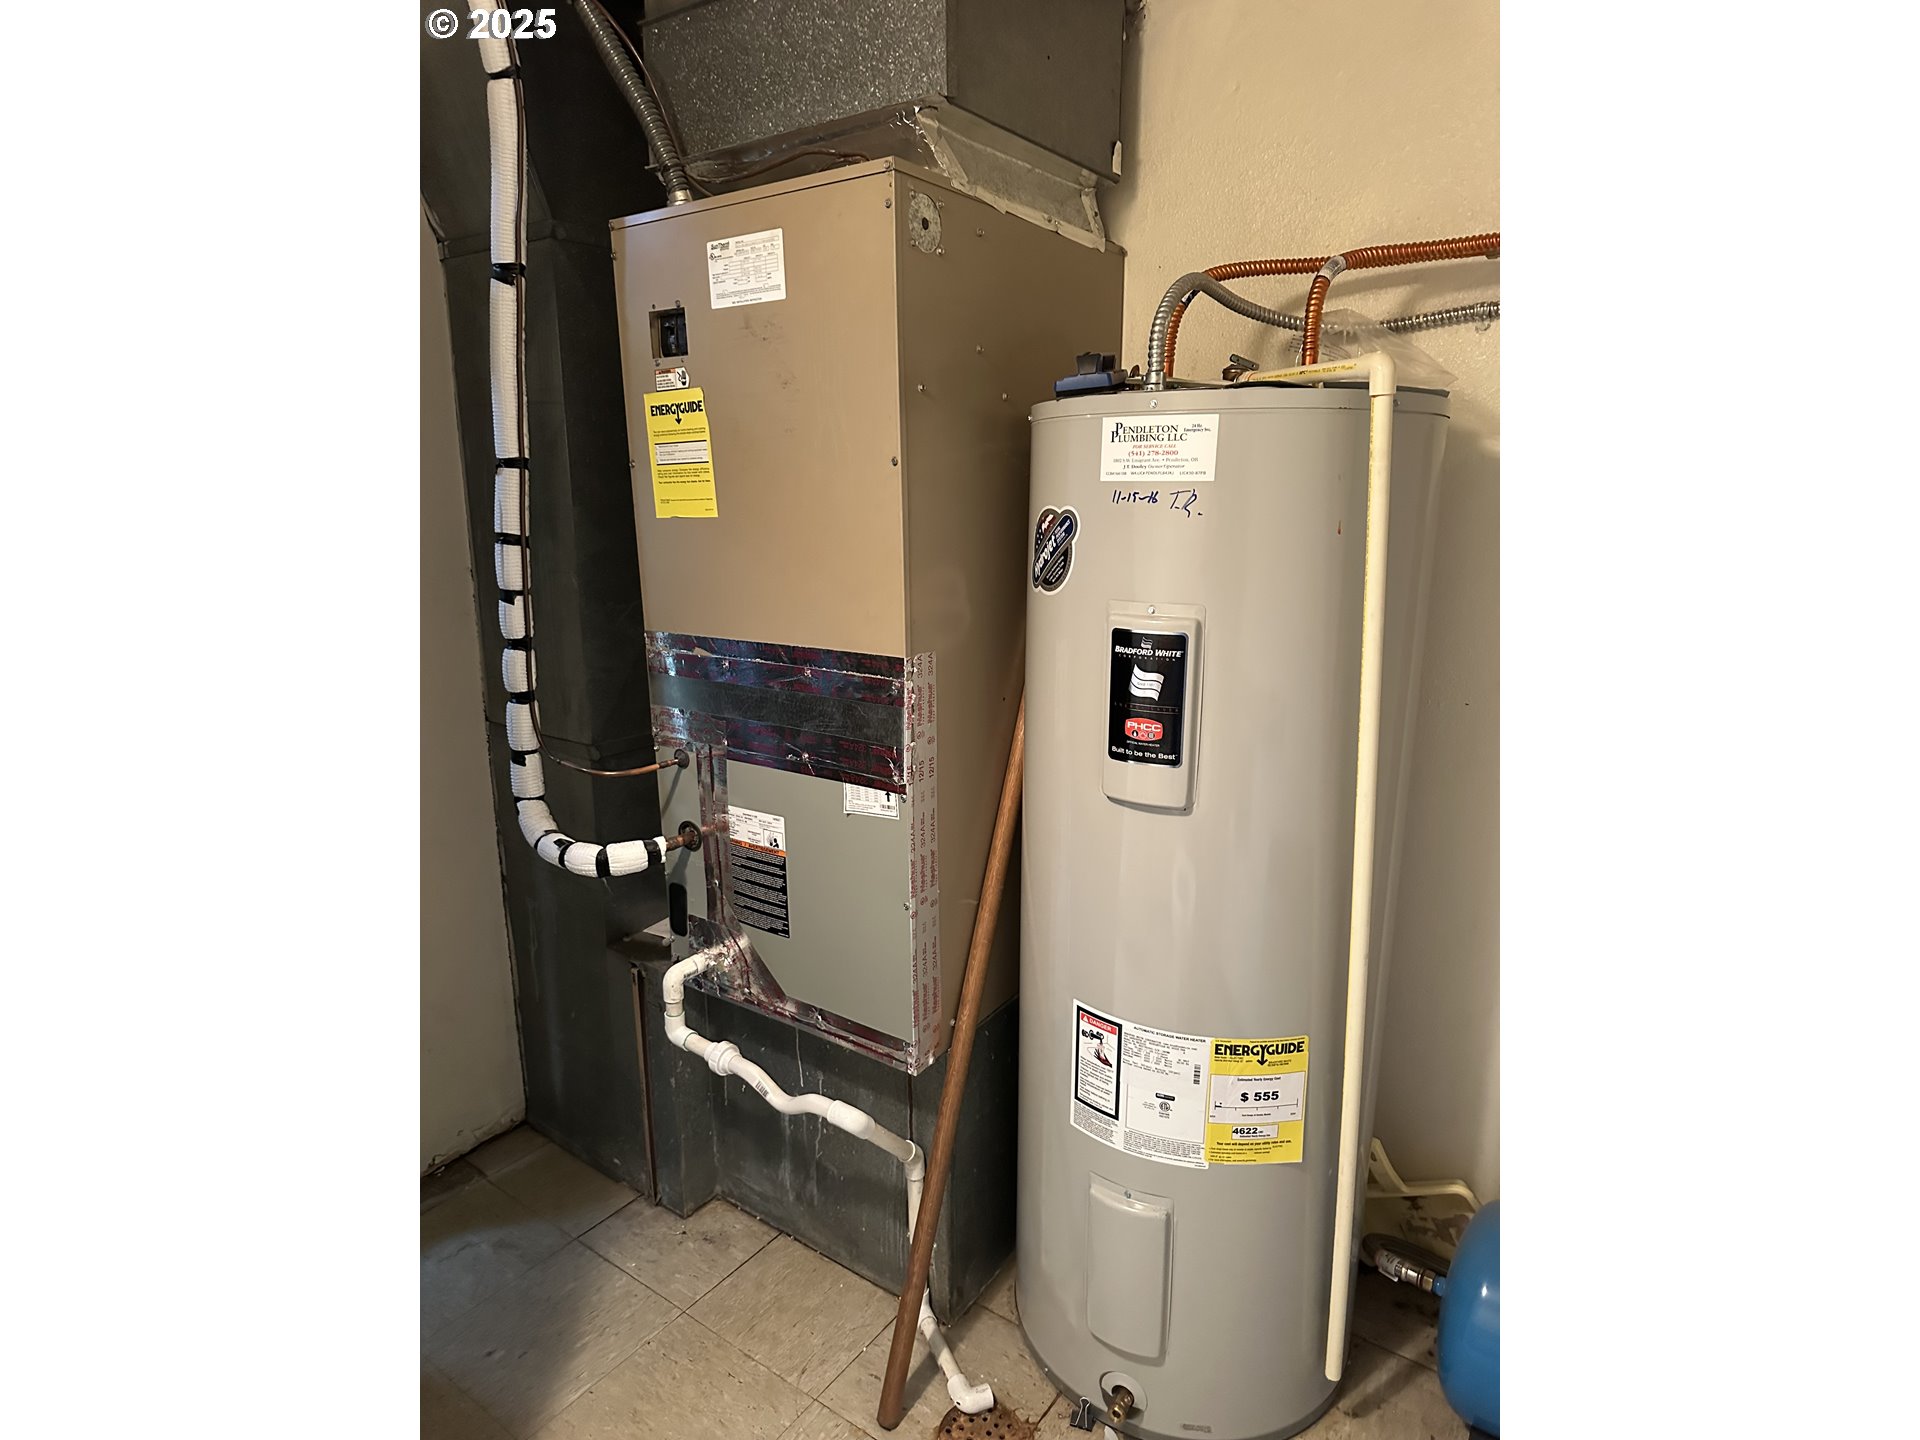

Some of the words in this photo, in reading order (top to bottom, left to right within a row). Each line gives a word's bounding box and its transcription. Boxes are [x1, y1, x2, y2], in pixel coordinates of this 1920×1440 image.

[650, 400, 703, 416] ENERGYGUIDE
[1115, 422, 1178, 436] PENDLETON
[1111, 431, 1164, 443] PLUMBING
[1167, 433, 1188, 442] LLC
[1115, 645, 1153, 656] BRADFORD
[1127, 721, 1161, 732] PHCC
[1112, 746, 1124, 754] Built
[1089, 1018, 1112, 1032] DANGER
[1134, 1026, 1155, 1035] AUTOMATIC
[1214, 1041, 1305, 1056] ENERGYGUIDE
[1240, 1092, 1249, 1102] $
[1254, 1091, 1279, 1101] 555
